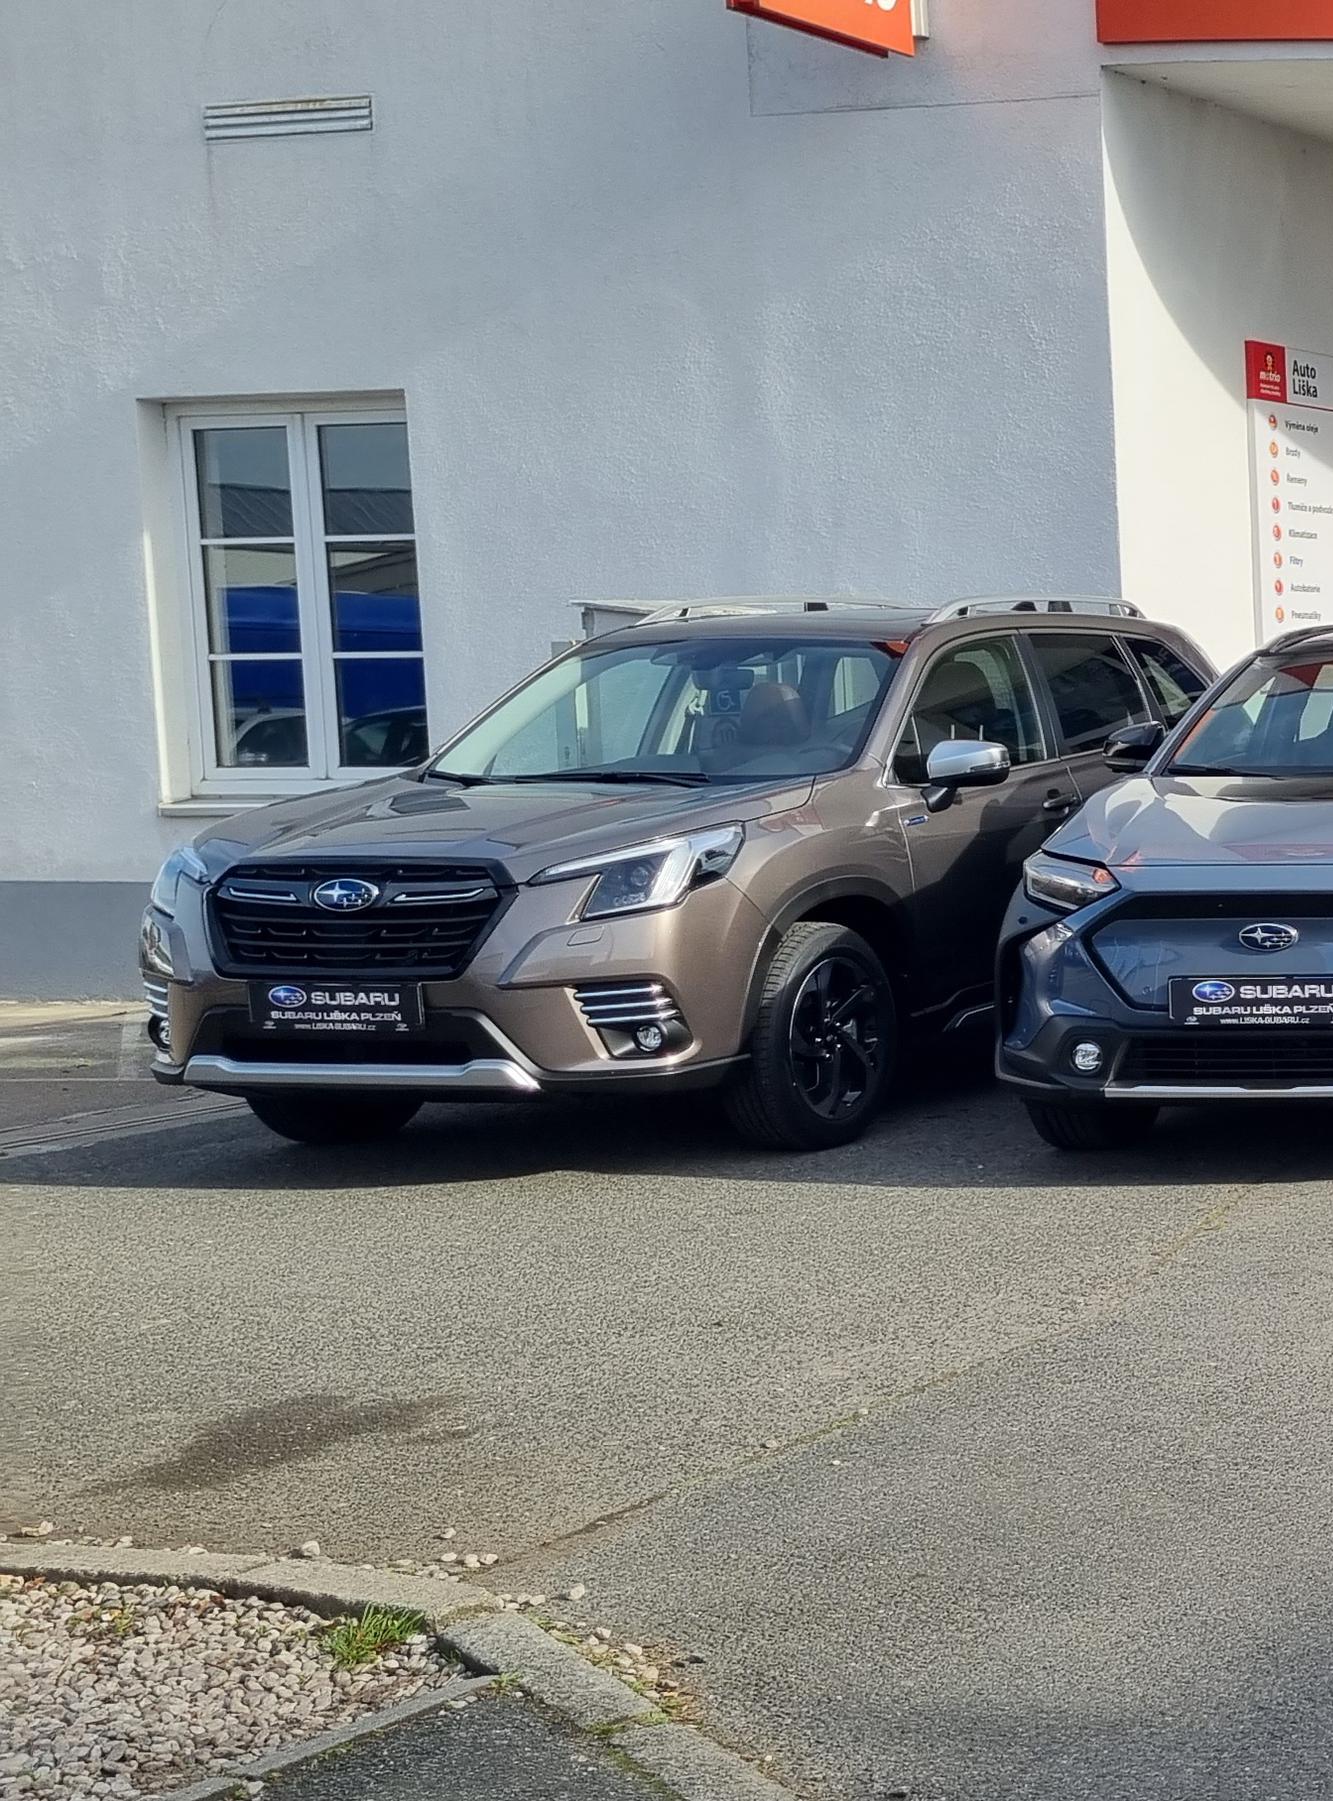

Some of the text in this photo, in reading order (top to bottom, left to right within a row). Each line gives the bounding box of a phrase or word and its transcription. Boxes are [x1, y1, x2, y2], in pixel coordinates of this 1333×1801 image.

[1292, 360, 1316, 379] Auto
[1293, 379, 1318, 398] Liška
[311, 991, 400, 1006] SUBARU
[270, 1010, 401, 1021] SUBARU LIŠKA PLZEŇ
[1193, 1006, 1251, 1015] SUBARU
[1253, 1004, 1291, 1015] LIŠKA
